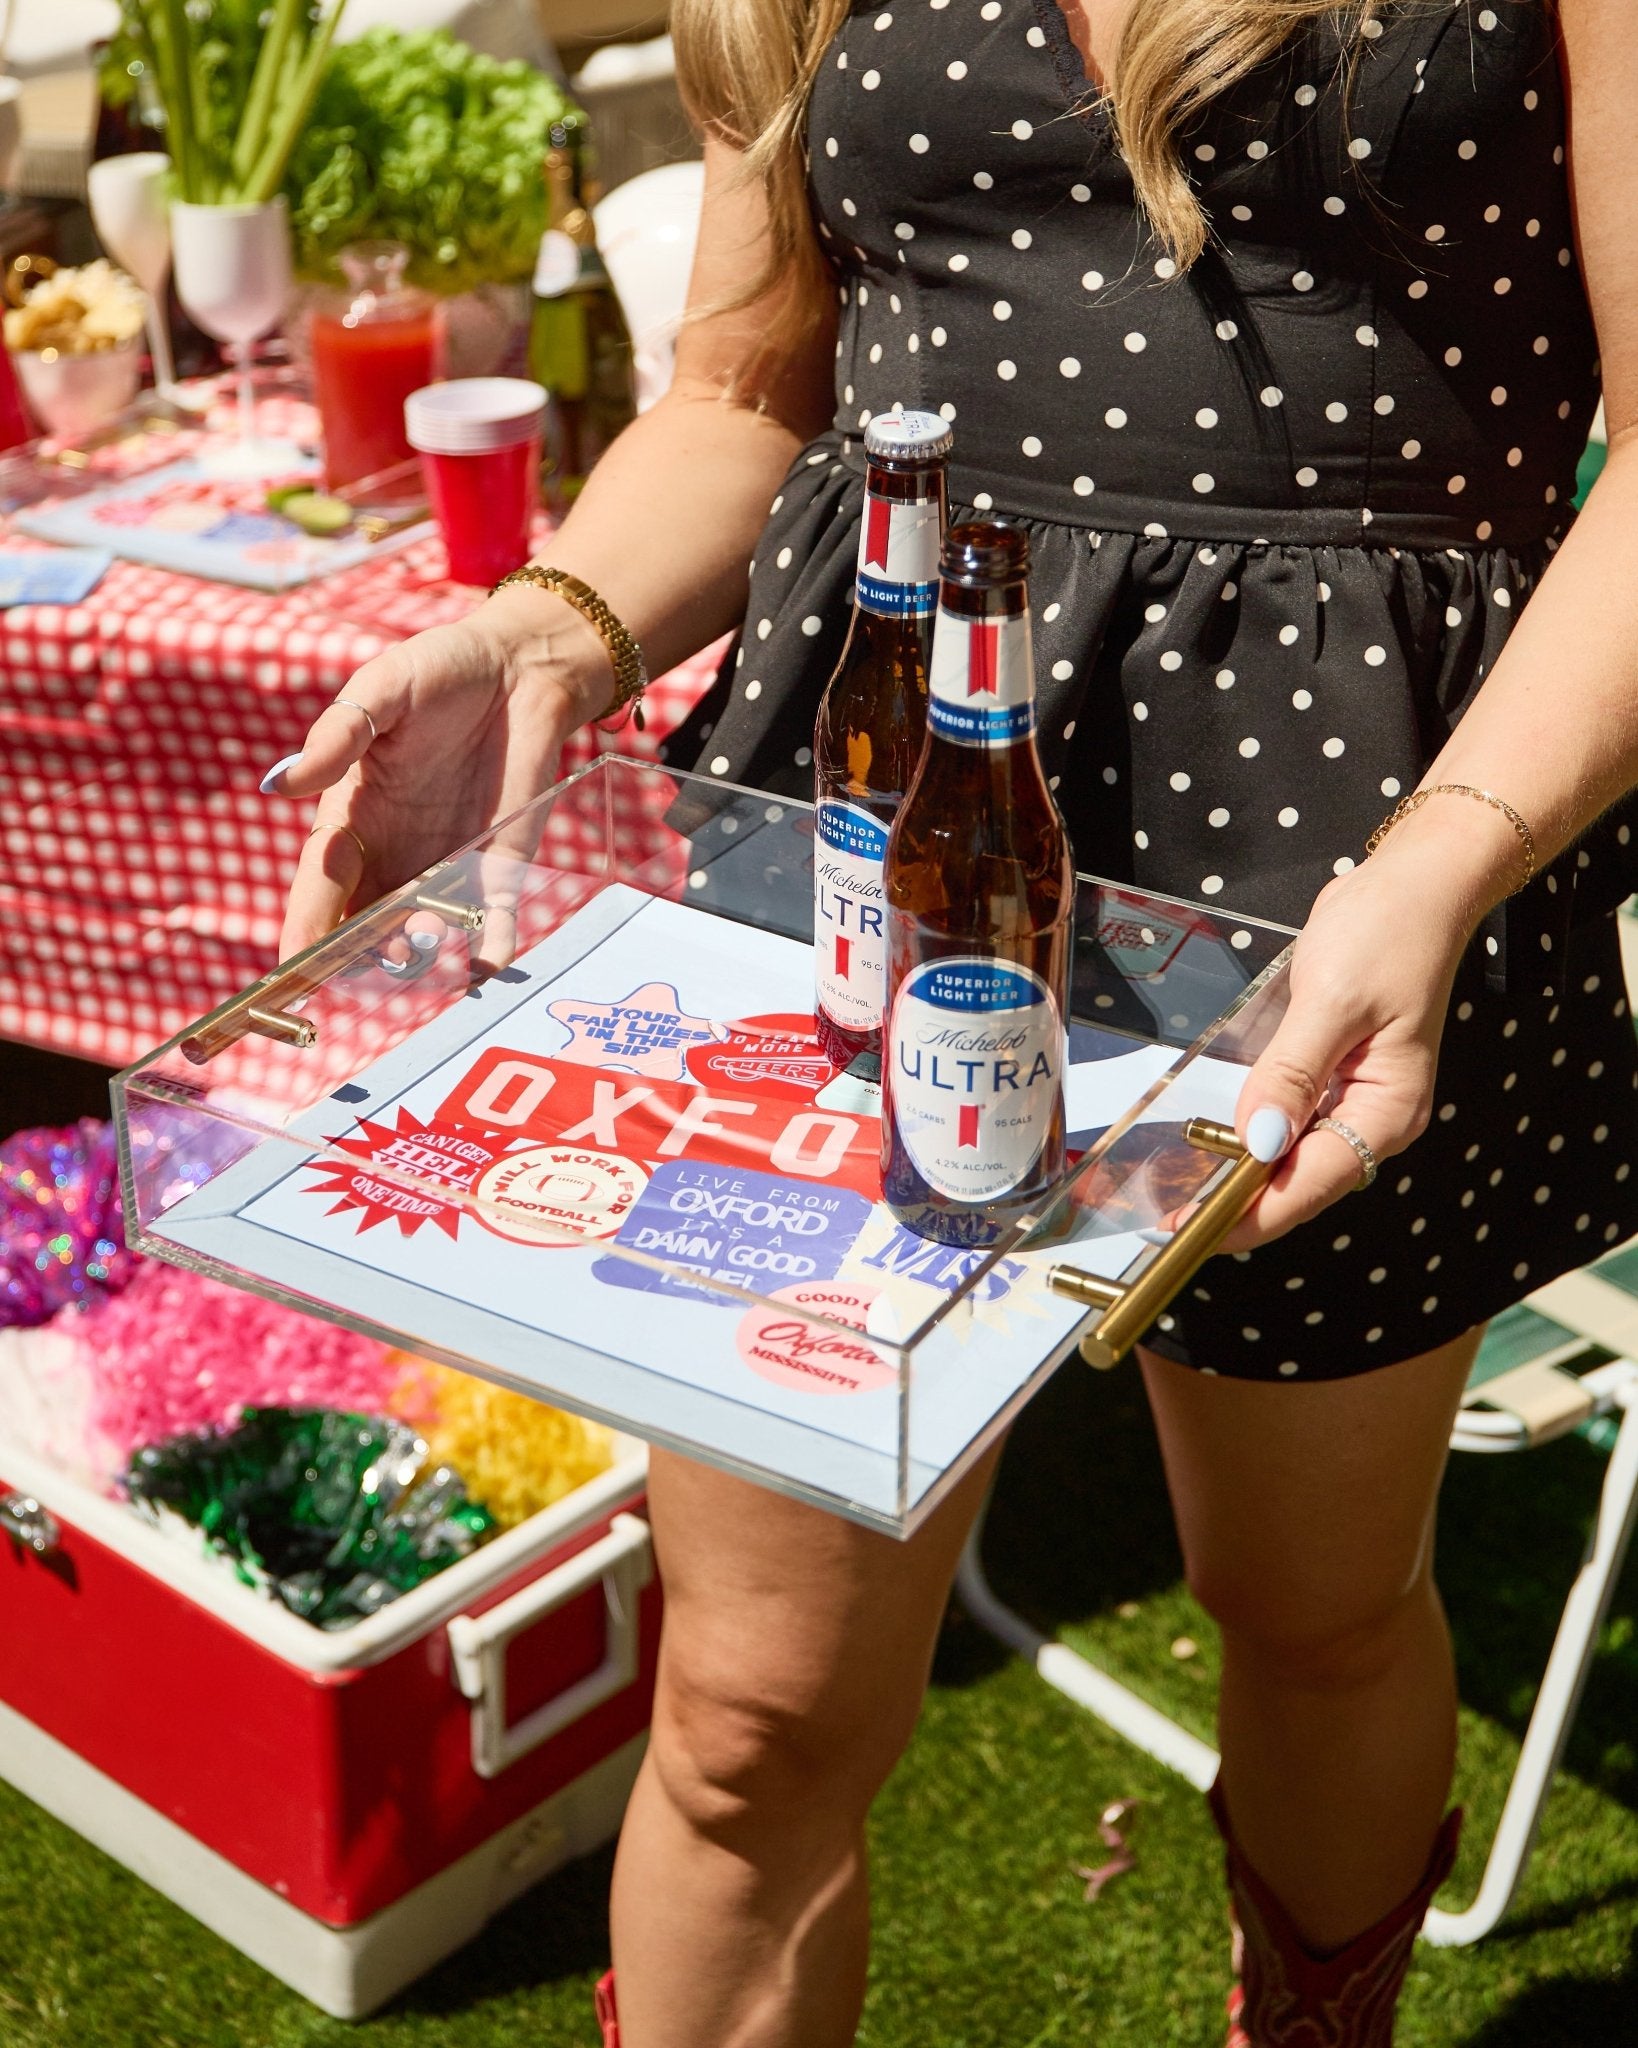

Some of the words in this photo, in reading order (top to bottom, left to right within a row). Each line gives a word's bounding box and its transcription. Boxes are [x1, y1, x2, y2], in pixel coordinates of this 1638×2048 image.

[870, 590, 900, 602] LIGHT
[904, 593, 932, 603] BEER
[978, 719, 1013, 731] LIGHT
[820, 821, 846, 842] LIGHT
[849, 837, 882, 853] BEER
[822, 810, 876, 839] SUPERIOR
[861, 959, 872, 969] 95
[936, 973, 1012, 988] SUPERIOR
[930, 985, 974, 1002] LIGHT
[980, 990, 1019, 1003] BEER
[567, 1013, 621, 1030] FAV
[626, 1020, 712, 1041] LIVES
[611, 1006, 682, 1027] YOUR
[586, 1026, 615, 1041] IN
[624, 1032, 681, 1049] THE
[602, 1041, 652, 1057] SIP
[742, 1043, 805, 1053] MORE
[915, 1022, 1032, 1052] Michelob
[726, 1060, 820, 1080] CHEERS
[901, 1040, 1054, 1093] ULTRA
[464, 1059, 861, 1178] OXFO
[919, 1111, 946, 1125] CARBS
[994, 1118, 1008, 1129] 95
[1010, 1114, 1032, 1127] CALS
[935, 1157, 960, 1170] 4.2%
[962, 1161, 1008, 1172] ALC./VOL.
[351, 1176, 394, 1204] ONE
[382, 1190, 445, 1215] TIME
[492, 1161, 542, 1193] WILL
[550, 1154, 627, 1178] WORK
[606, 1181, 635, 1215] FOR
[676, 1171, 746, 1194] LIVE
[767, 1188, 841, 1213] FROM
[494, 1195, 603, 1226] FOOTBALL
[669, 1187, 829, 1236] OXFORD
[678, 1217, 746, 1240] IT'S
[766, 1234, 783, 1248] A
[633, 1227, 723, 1261] DAMN
[727, 1244, 817, 1278] GOOD
[795, 1292, 860, 1307] GOOD
[748, 1344, 860, 1390] MISSISSIPPI
